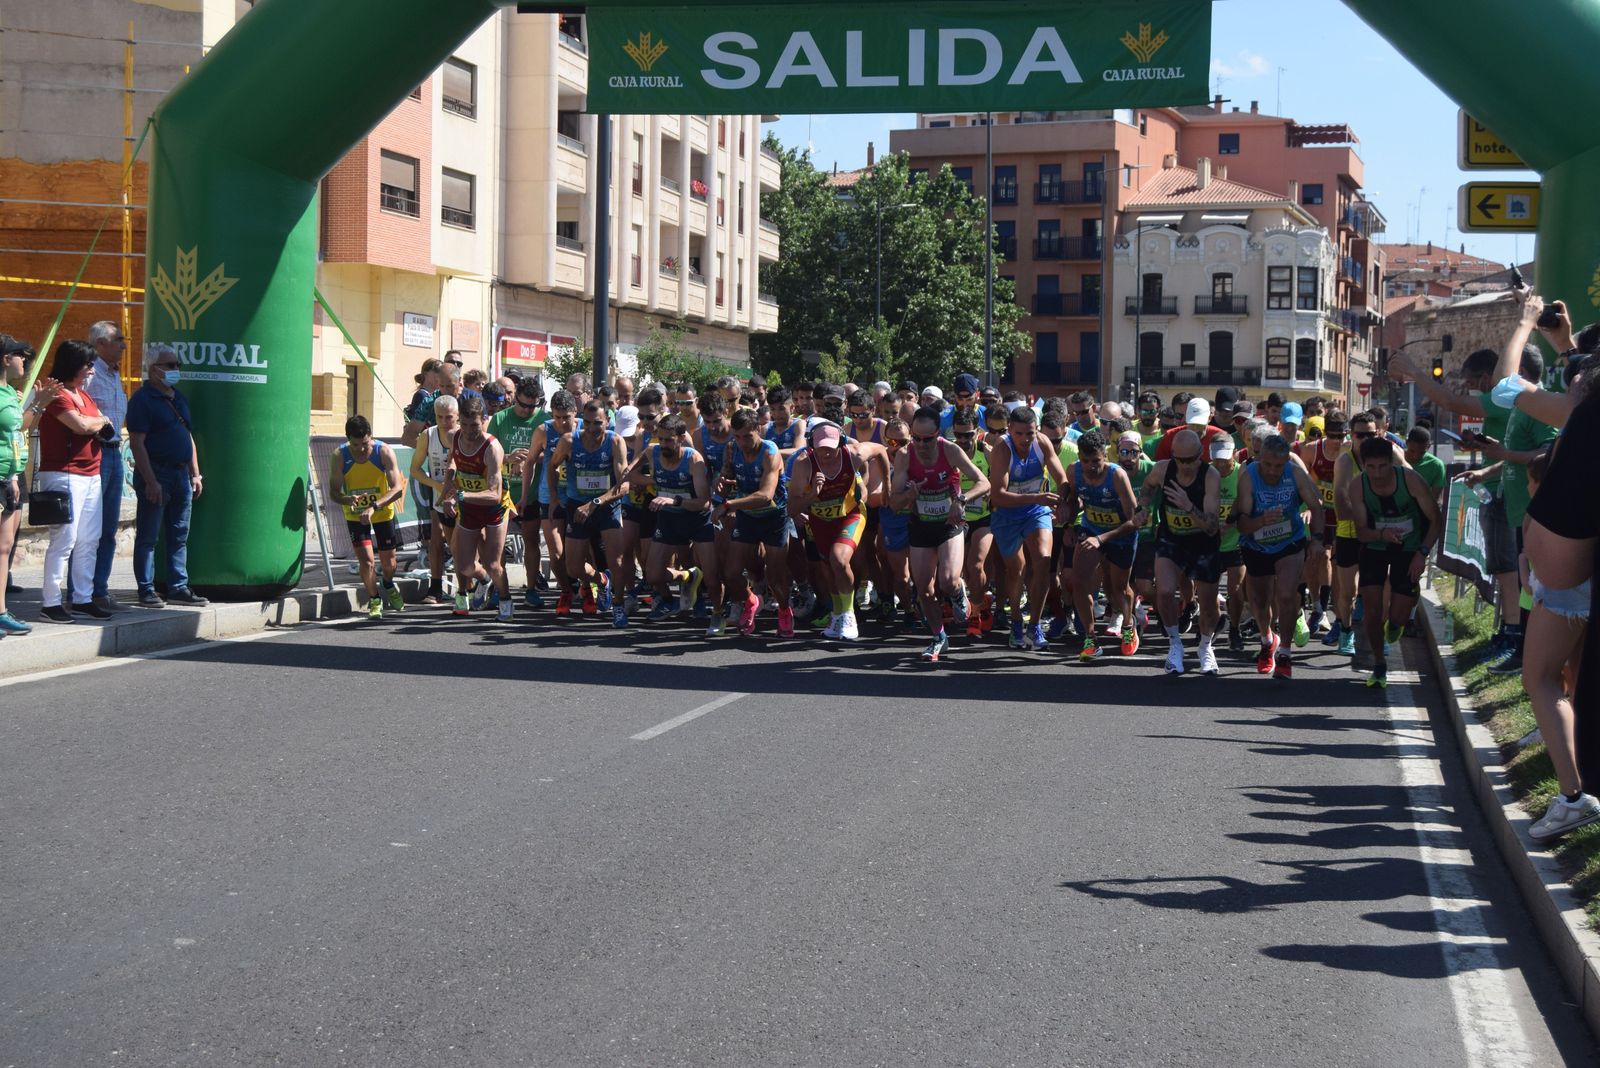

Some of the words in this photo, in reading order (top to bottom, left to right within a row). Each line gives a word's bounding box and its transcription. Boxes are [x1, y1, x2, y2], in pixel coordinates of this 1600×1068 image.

[700, 26, 1084, 90] SALIDA
[1102, 69, 1135, 82] CAJA
[1136, 66, 1185, 80] RURAL
[608, 76, 638, 88] CAJA
[639, 76, 684, 88] RURAL
[1474, 142, 1512, 153] hote
[171, 341, 268, 368] RURAL
[231, 374, 260, 382] ZAMORA
[461, 478, 483, 490] 182
[814, 505, 842, 517] 227
[1090, 511, 1114, 523] 113
[1172, 516, 1193, 528] 49
